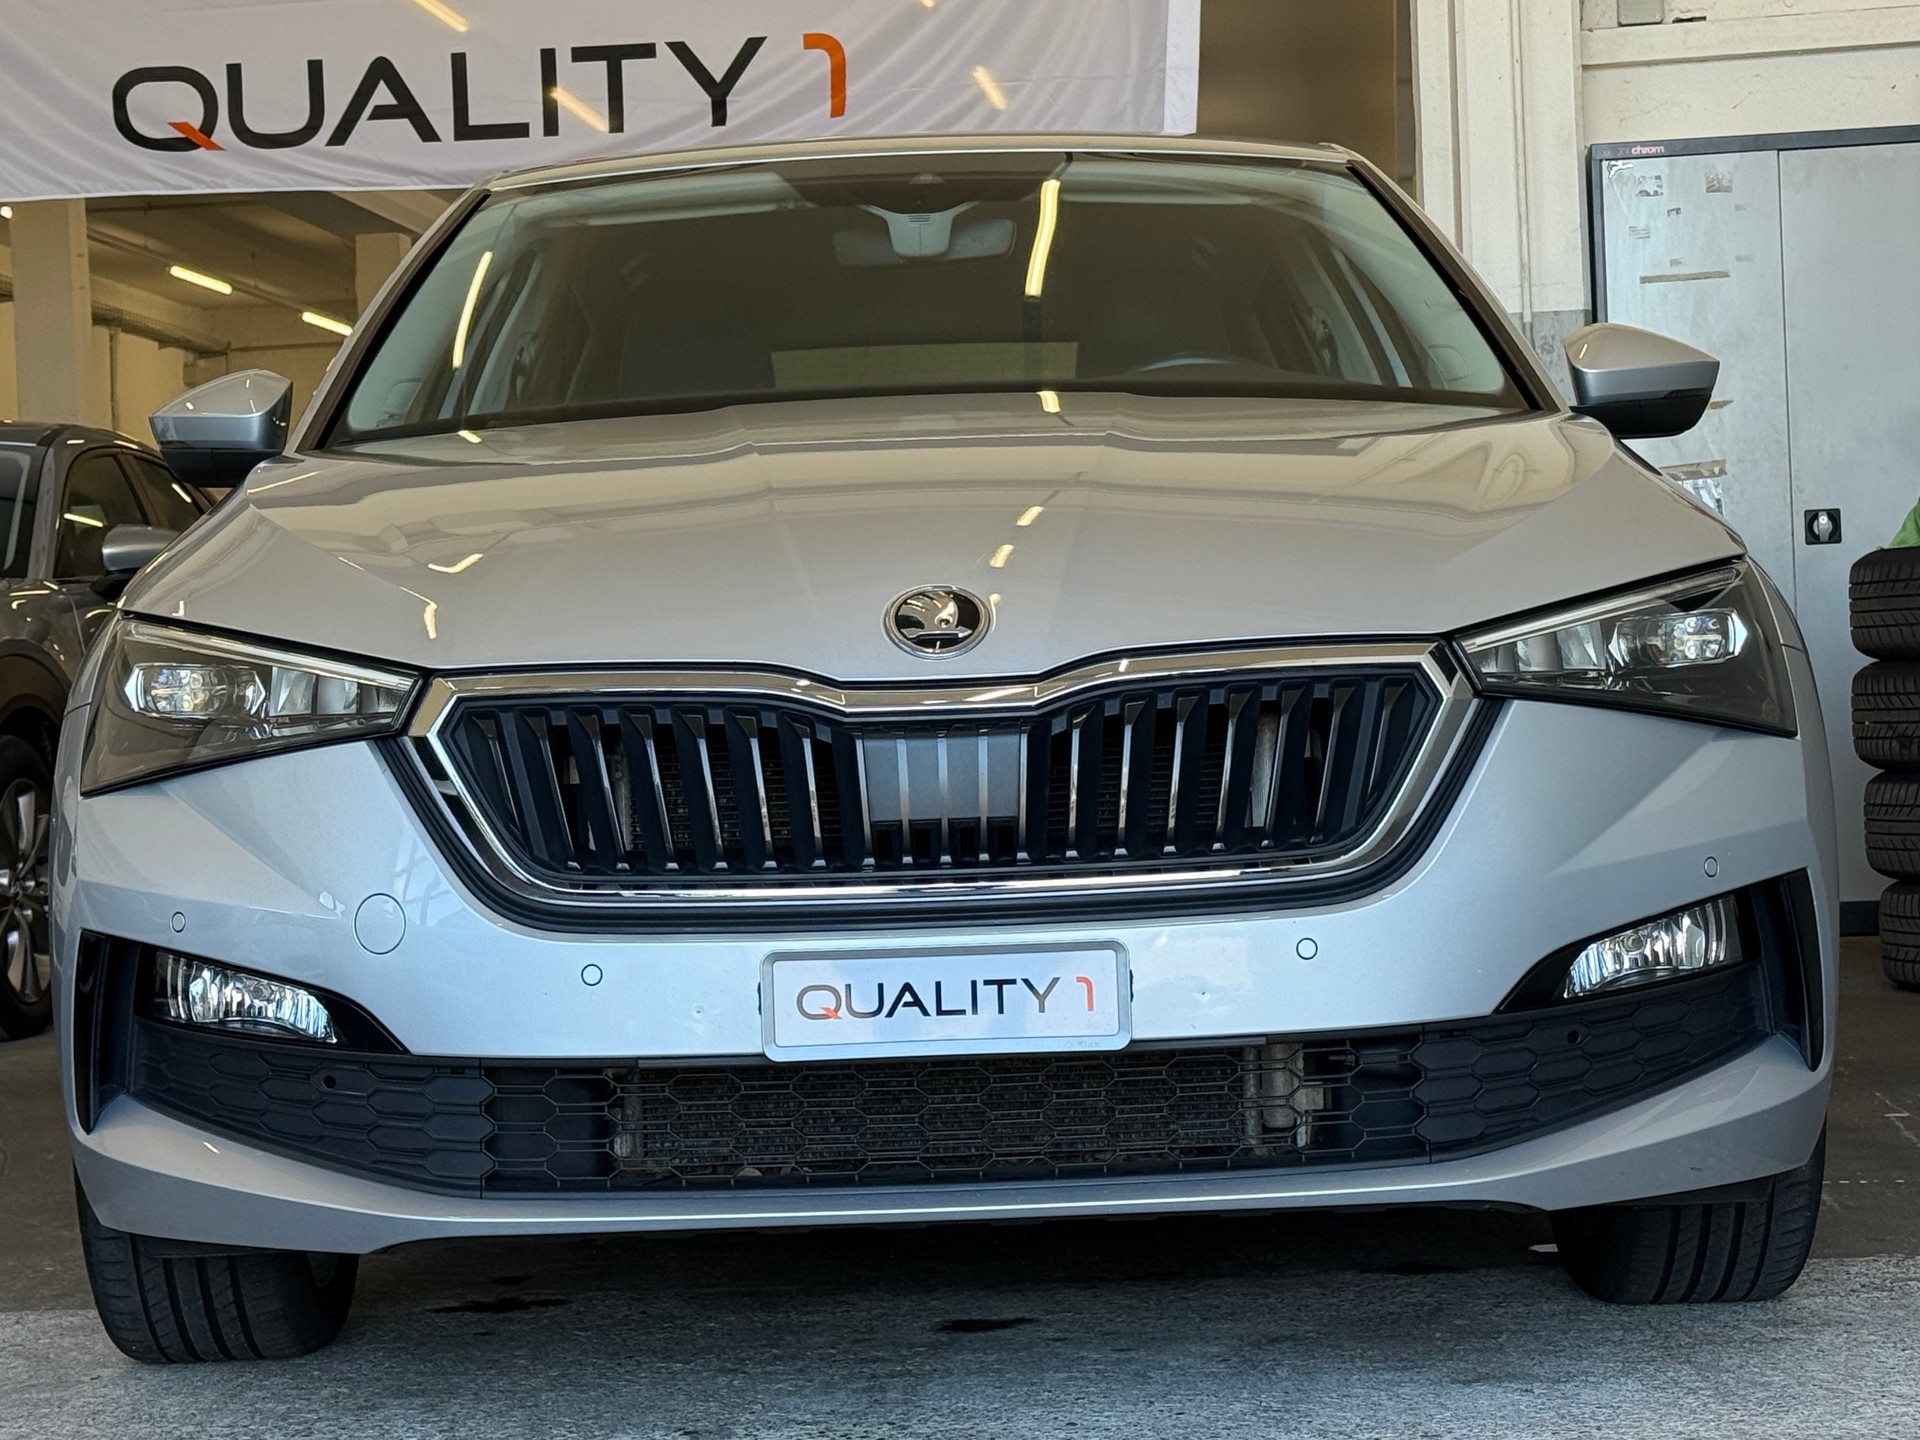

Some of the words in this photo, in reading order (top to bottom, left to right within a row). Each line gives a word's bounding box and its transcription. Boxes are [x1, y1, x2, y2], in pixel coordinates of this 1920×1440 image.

[112, 36, 767, 152] QUALITY
[802, 32, 847, 119] 1
[797, 977, 1060, 1020] QUALITY
[1076, 976, 1094, 1012] 1
